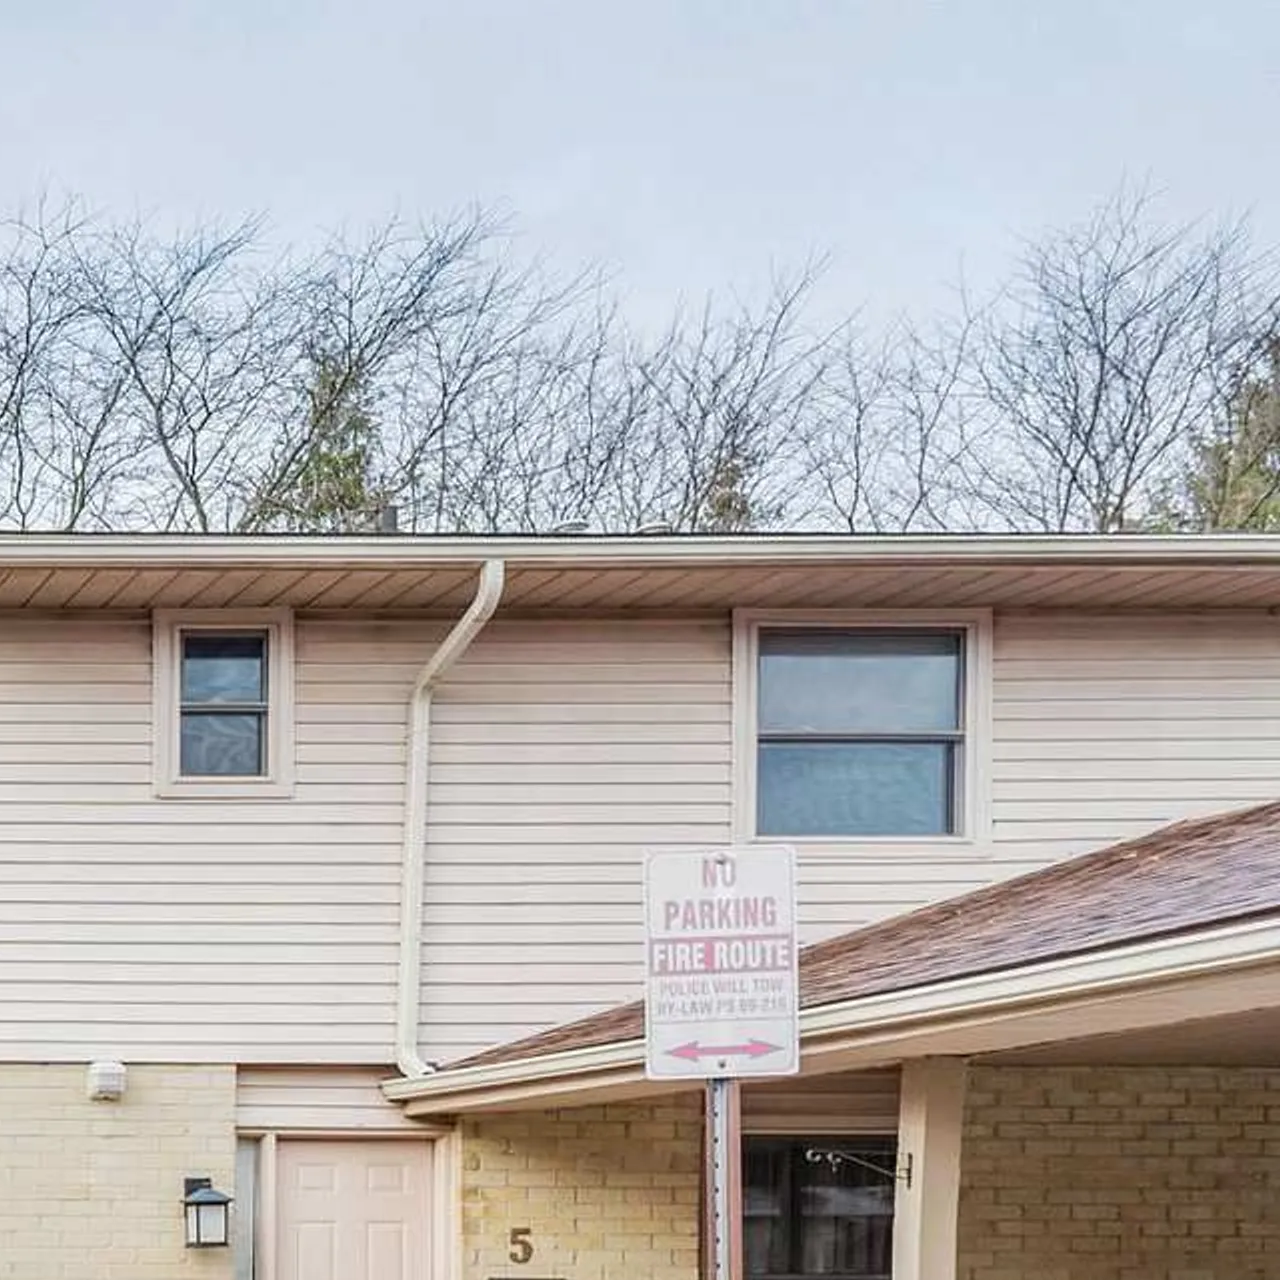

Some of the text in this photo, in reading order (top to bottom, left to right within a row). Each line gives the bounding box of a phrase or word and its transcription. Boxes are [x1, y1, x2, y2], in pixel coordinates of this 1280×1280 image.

[702, 856, 736, 887] NO
[664, 896, 777, 930] PARKING
[653, 938, 790, 972] FIRE ROUTE
[660, 977, 783, 997] POLICE WILL TOW
[510, 1228, 533, 1264] 5
